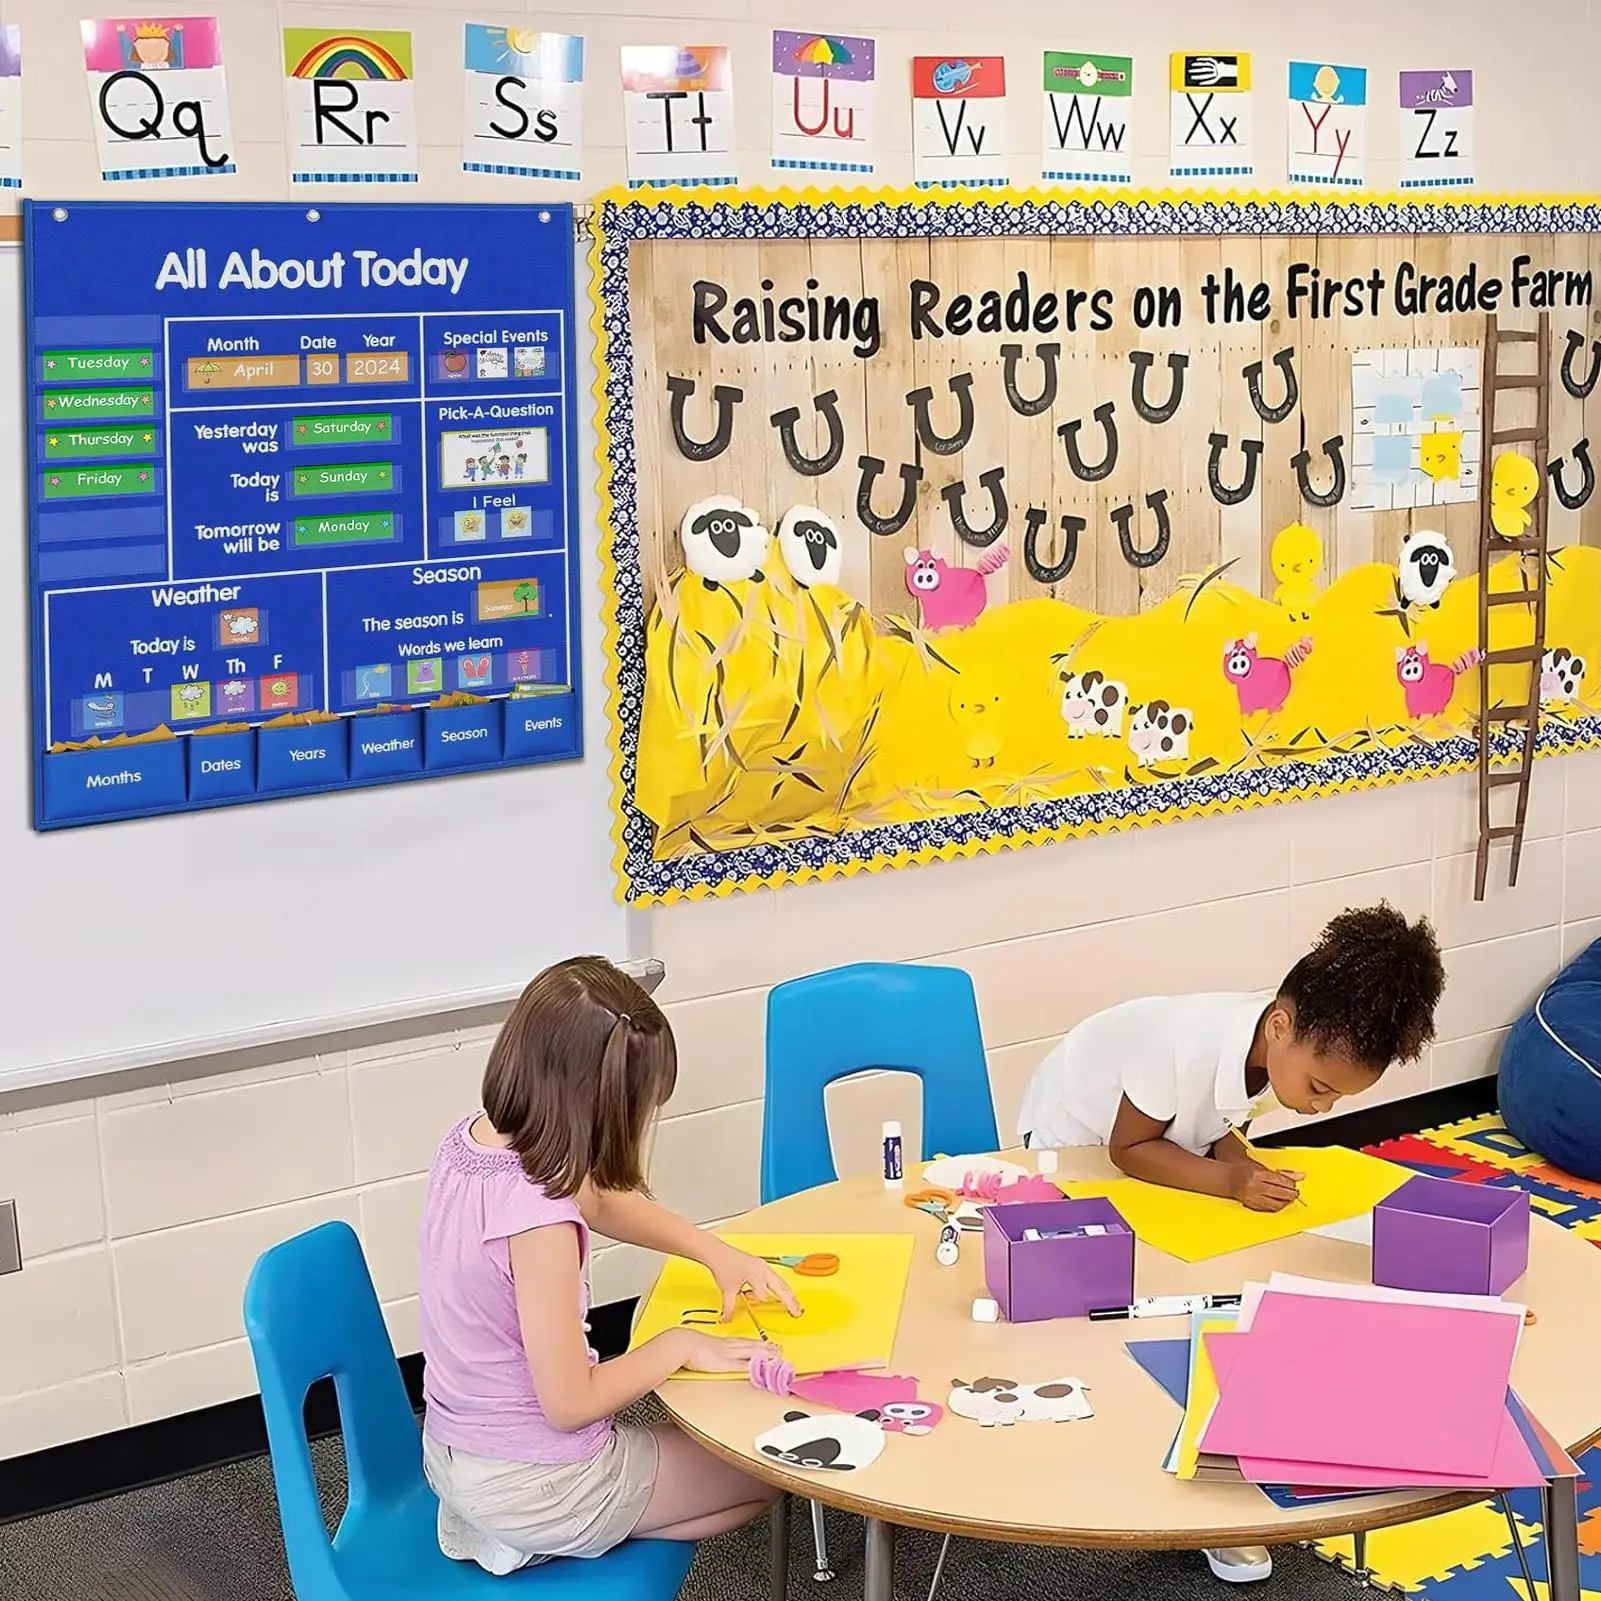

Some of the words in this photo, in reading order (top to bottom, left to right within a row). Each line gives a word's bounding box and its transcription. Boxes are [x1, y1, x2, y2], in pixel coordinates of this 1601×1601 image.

[314, 79, 390, 145] Rr
[490, 76, 559, 142] Ss
[794, 76, 853, 138] Uu
[100, 71, 229, 168] Qq
[646, 91, 713, 151] Tt
[936, 99, 986, 155] Vv
[1049, 93, 1126, 151] Ww
[1184, 93, 1238, 146] Xx
[1302, 102, 1351, 179] Yy
[1414, 109, 1460, 159] Zz
[155, 248, 207, 290] All
[218, 248, 345, 290] About
[353, 247, 469, 294] Today
[692, 279, 881, 358] Raising
[909, 271, 1114, 341] Readers
[1133, 285, 1182, 328] on
[1200, 267, 1271, 324] the
[1286, 262, 1385, 319] First
[1394, 262, 1502, 316] Grade
[1511, 255, 1593, 309] Farm
[207, 336, 260, 352] Month
[300, 335, 337, 350] Date
[362, 333, 396, 348] Year
[443, 331, 497, 348] Special
[501, 329, 549, 343] Events
[67, 356, 131, 372] Tuesday
[233, 362, 275, 378] April
[311, 361, 333, 376] 30
[354, 359, 401, 376] 2024
[58, 394, 139, 412] Wednesday
[438, 404, 554, 421] Pick-A-Question
[194, 423, 279, 441] Yesterday
[313, 422, 372, 434] Saturday
[68, 431, 135, 448] Thursday
[242, 440, 279, 453] was
[77, 473, 123, 490] Friday
[230, 472, 280, 488] Today
[319, 470, 368, 484] Sunday
[265, 487, 279, 502] is
[472, 497, 477, 509] I
[483, 494, 516, 508] Feel
[194, 522, 280, 540] Tomorrow
[318, 518, 370, 533] Monday
[223, 537, 253, 554] will
[257, 537, 280, 551] be
[412, 565, 481, 585] Season
[152, 584, 241, 607] Weather
[362, 617, 391, 633] The
[394, 614, 448, 630] season
[452, 611, 464, 625] is
[130, 638, 179, 655] Today
[183, 636, 196, 651] is
[398, 641, 441, 657] Words
[444, 639, 466, 652] we
[468, 635, 503, 651] learn
[226, 657, 246, 675] Th
[273, 654, 283, 669] F
[142, 667, 153, 684] T
[182, 663, 199, 680] W
[94, 672, 113, 689] M
[524, 717, 563, 732] Events
[441, 727, 488, 743] Season
[289, 748, 327, 762] Years
[361, 738, 415, 755] Weather
[201, 758, 242, 774] Dates
[86, 770, 142, 788] Months
